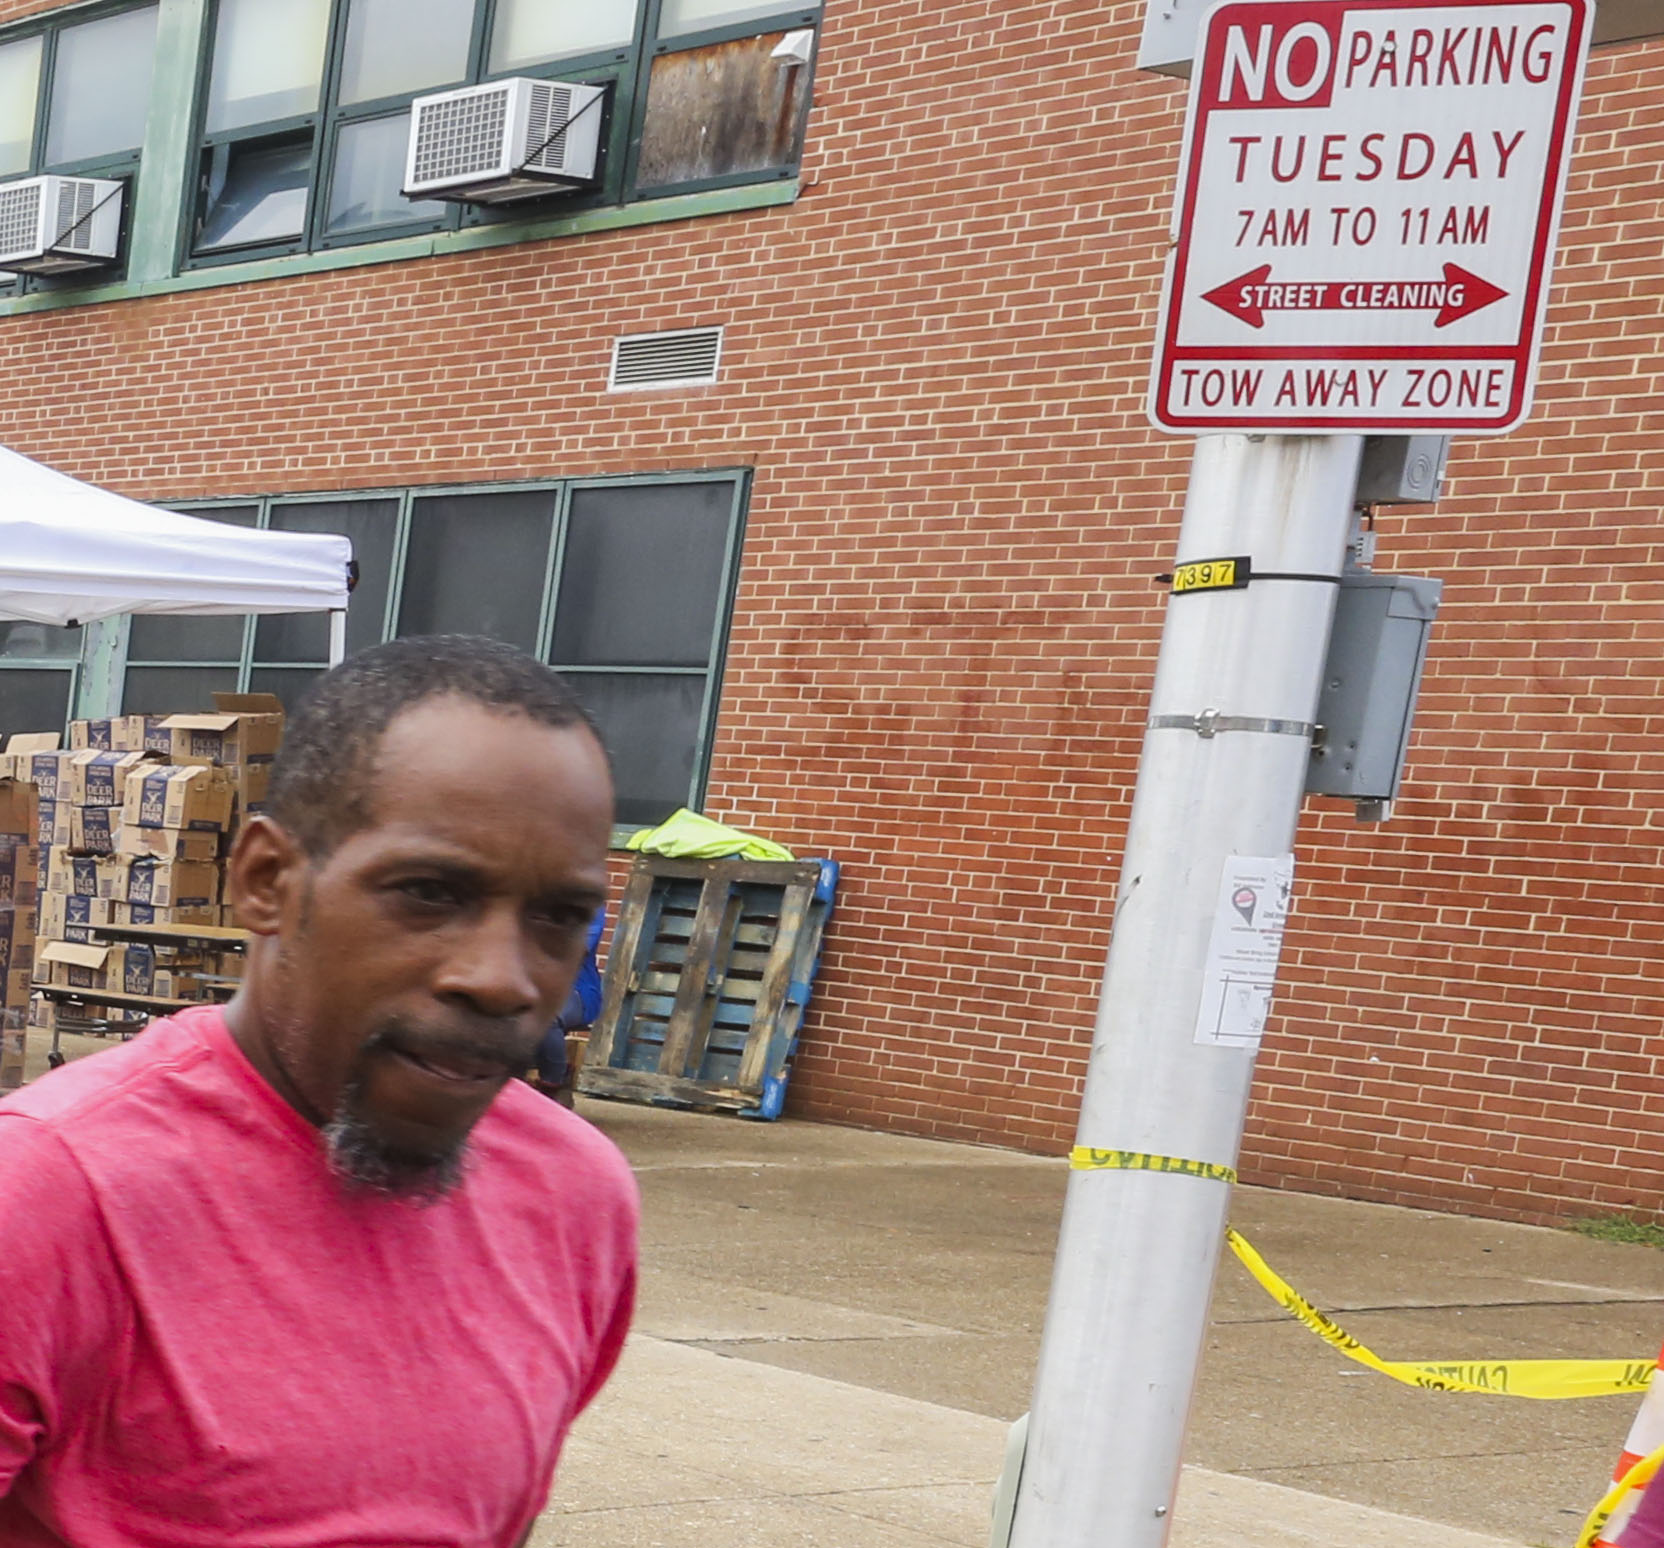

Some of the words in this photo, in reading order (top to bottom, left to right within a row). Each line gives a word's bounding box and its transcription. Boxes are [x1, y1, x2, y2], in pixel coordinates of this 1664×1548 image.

[1217, 21, 1332, 103] NO
[1344, 23, 1556, 89] PARKING
[1228, 130, 1526, 184] TUESDAY
[1331, 207, 1378, 247] TO
[1238, 284, 1328, 309] STREET
[1340, 282, 1465, 308] CLEANING
[1180, 368, 1264, 408] TOW
[1274, 368, 1388, 408] AWAY
[1401, 368, 1504, 408] ZONE
[1176, 563, 1233, 587] 7397
[86, 784, 113, 796] DEER
[85, 829, 110, 840] DEER
[85, 839, 111, 851] PARK
